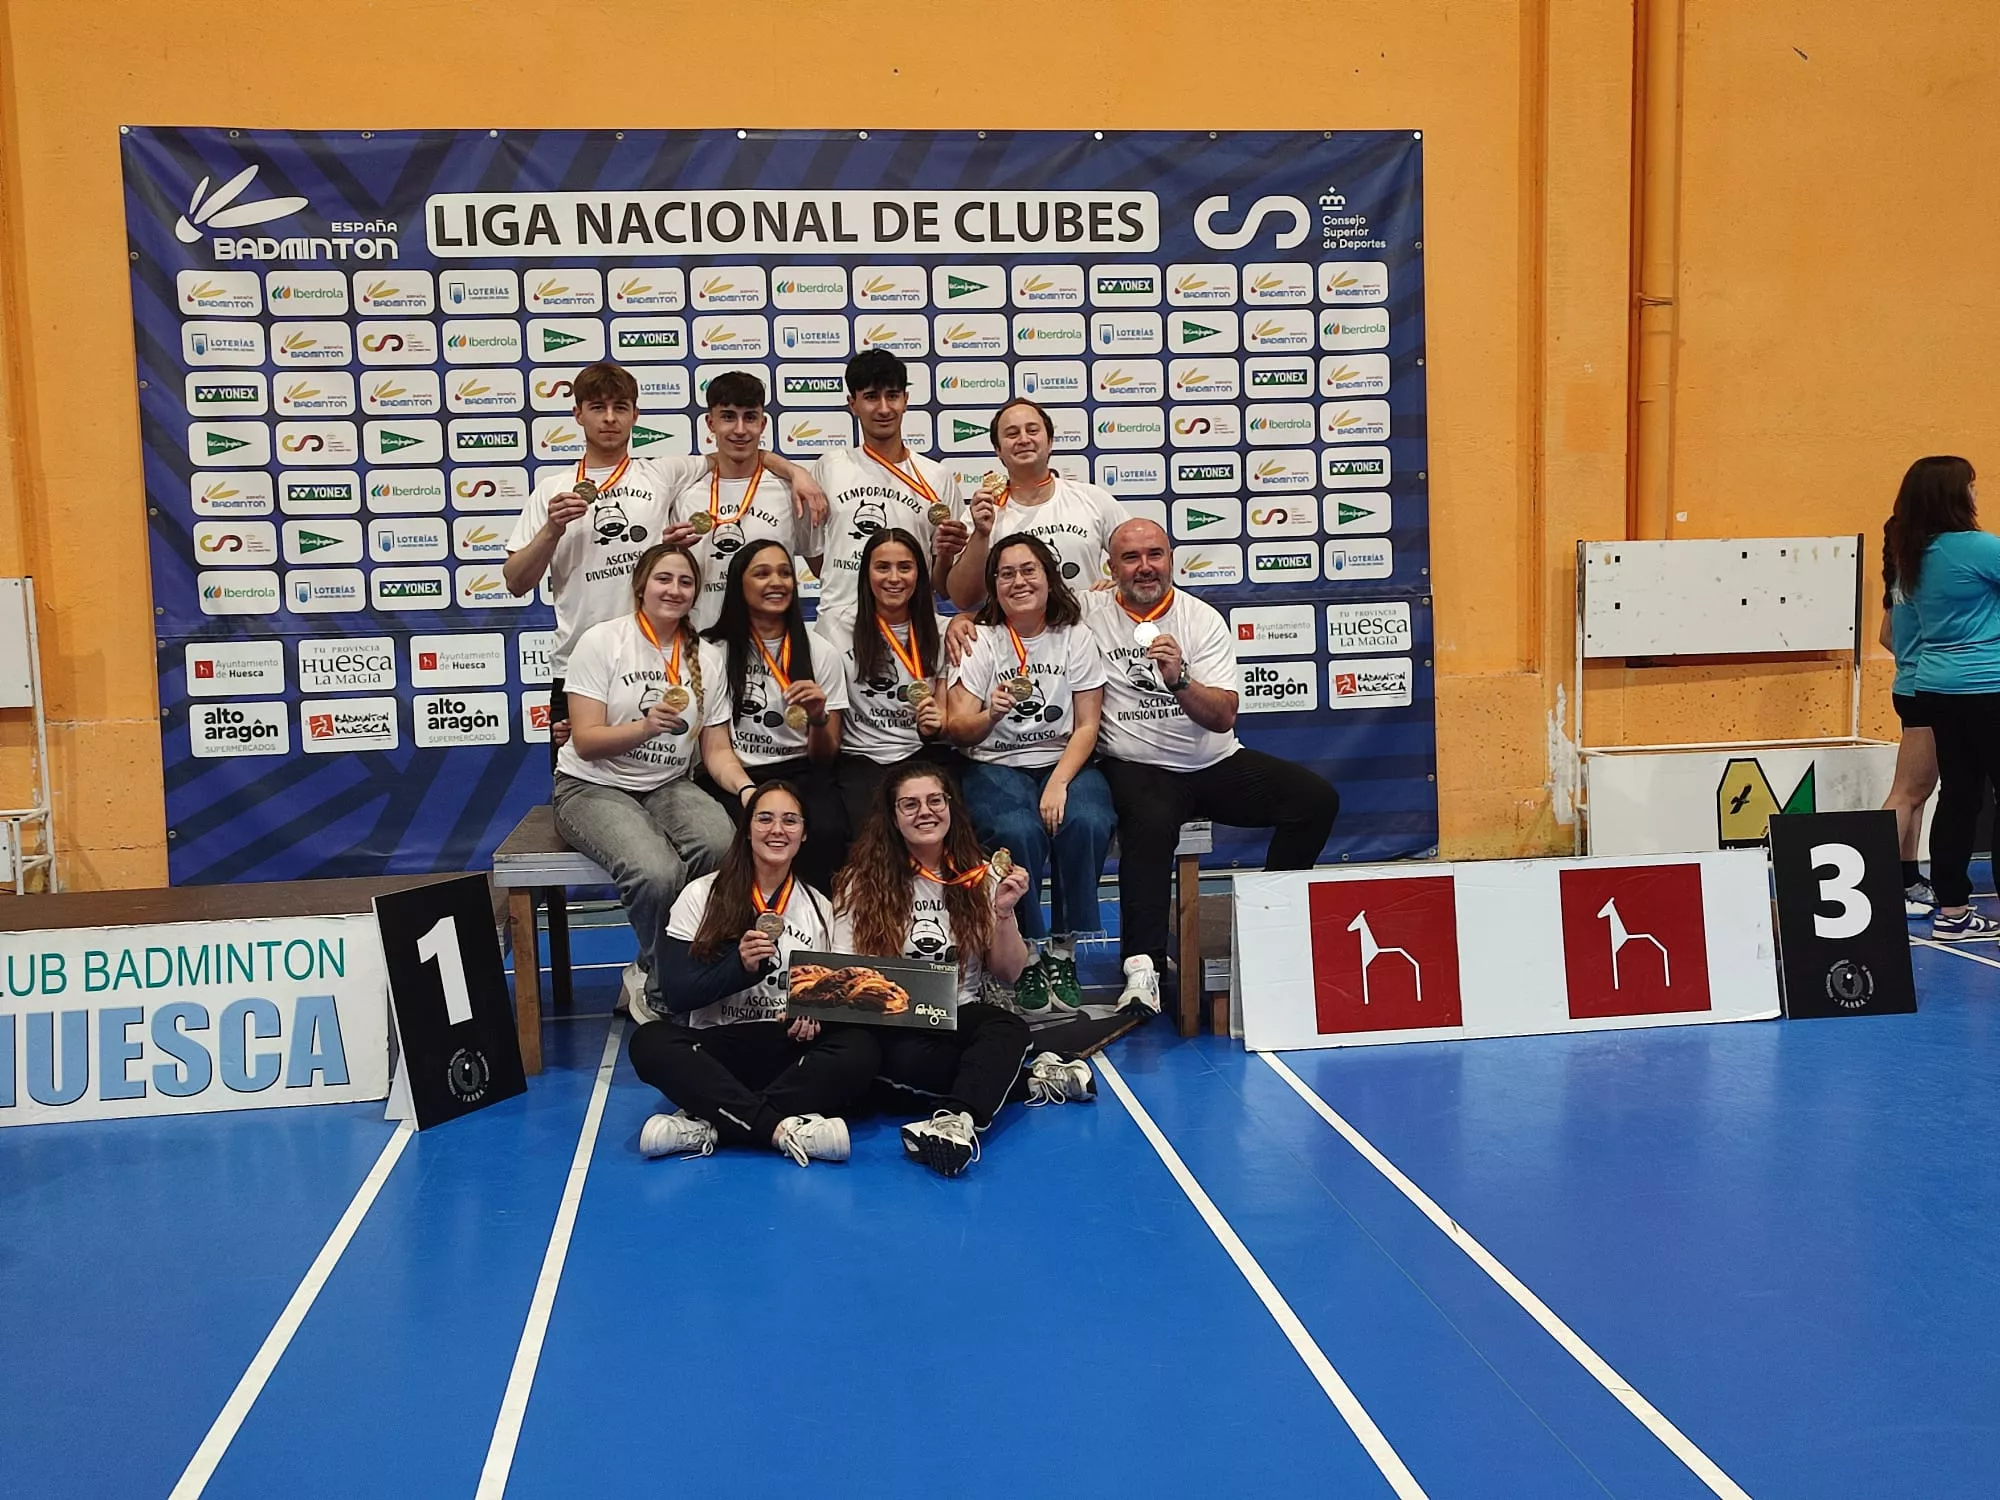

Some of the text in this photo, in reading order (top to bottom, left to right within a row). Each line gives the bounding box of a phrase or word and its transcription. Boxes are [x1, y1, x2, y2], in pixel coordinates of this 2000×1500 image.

[434, 201, 1144, 247] LIGA NACIONAL DE CLUBES
[1323, 215, 1366, 226] Consejo
[331, 220, 397, 234] ESPAÑA
[1323, 227, 1369, 238] Superior
[214, 238, 398, 261] BADMINTON
[1323, 239, 1386, 250] de Deportes
[469, 287, 509, 295] LOTERÍAS
[797, 283, 843, 293] Iberdrola
[1119, 280, 1150, 291] YONEX
[293, 288, 343, 299] Iberdrola
[198, 300, 254, 308] BADMINTON
[1038, 330, 1081, 339] Iberdrola
[1116, 328, 1154, 337] LOTERÍAS
[1342, 324, 1385, 334] Iberdrola
[469, 336, 517, 347] Iberdrola
[643, 332, 675, 344] YONEX
[801, 332, 840, 340] LOTERÍAS
[211, 339, 255, 347] LOTERÍAS
[1041, 377, 1078, 385] LOTERÍAS
[1273, 372, 1304, 383] YONEX
[640, 382, 680, 390] LOTERÍAS
[806, 379, 839, 390] YONEX
[961, 379, 1005, 388] Iberdrola
[1336, 381, 1383, 389] BADMINTON
[220, 388, 255, 399] YONEX
[1117, 423, 1160, 433] Iberdrola
[1269, 419, 1311, 429] Iberdrola
[481, 435, 515, 445] YONEX
[1200, 467, 1231, 477] YONEX
[1351, 461, 1380, 472] YONEX
[1120, 470, 1157, 478] LOTERÍAS
[312, 487, 347, 498] YONEX
[392, 485, 441, 496] Iberdrola
[630, 488, 653, 501] 2025
[837, 486, 924, 514] TEMPORADA 2025
[756, 510, 779, 527] 2025
[1066, 524, 1088, 538] 2025
[397, 536, 438, 544] LOTERÍAS
[1277, 556, 1308, 567] YONEX
[1349, 554, 1384, 563] LOTERÍAS
[586, 566, 624, 582] DIVISIÓN
[1189, 570, 1236, 578] BADMINTON
[224, 588, 275, 598] Iberdrola
[314, 586, 355, 594] LOTERÍAS
[404, 583, 439, 594] YONEX
[1256, 621, 1310, 631] Ayuntamiento
[1256, 631, 1297, 640] de Huesca
[440, 652, 500, 660] Ayuntamiento
[216, 659, 279, 669] Ayuntamiento
[440, 661, 485, 670] de Huesca
[216, 669, 264, 678] de Huesca
[1245, 667, 1279, 683] alto
[1358, 681, 1406, 692] HUESCA
[427, 698, 465, 714] alto
[1245, 700, 1305, 709] SUPERMERCADOS
[204, 708, 244, 724] alto
[1118, 709, 1156, 721] DIVISIÓN
[335, 723, 391, 734] HUESCA
[429, 733, 496, 743] SUPERMERCADOS
[1016, 730, 1056, 742] ASCENSO
[205, 744, 275, 753] SUPERMERCADOS
[1810, 842, 1873, 939] 3
[83, 938, 346, 993] BADMINTON
[416, 915, 473, 1026] 1
[929, 963, 957, 972] Trenza
[721, 1005, 763, 1019] DIVISIÓN
